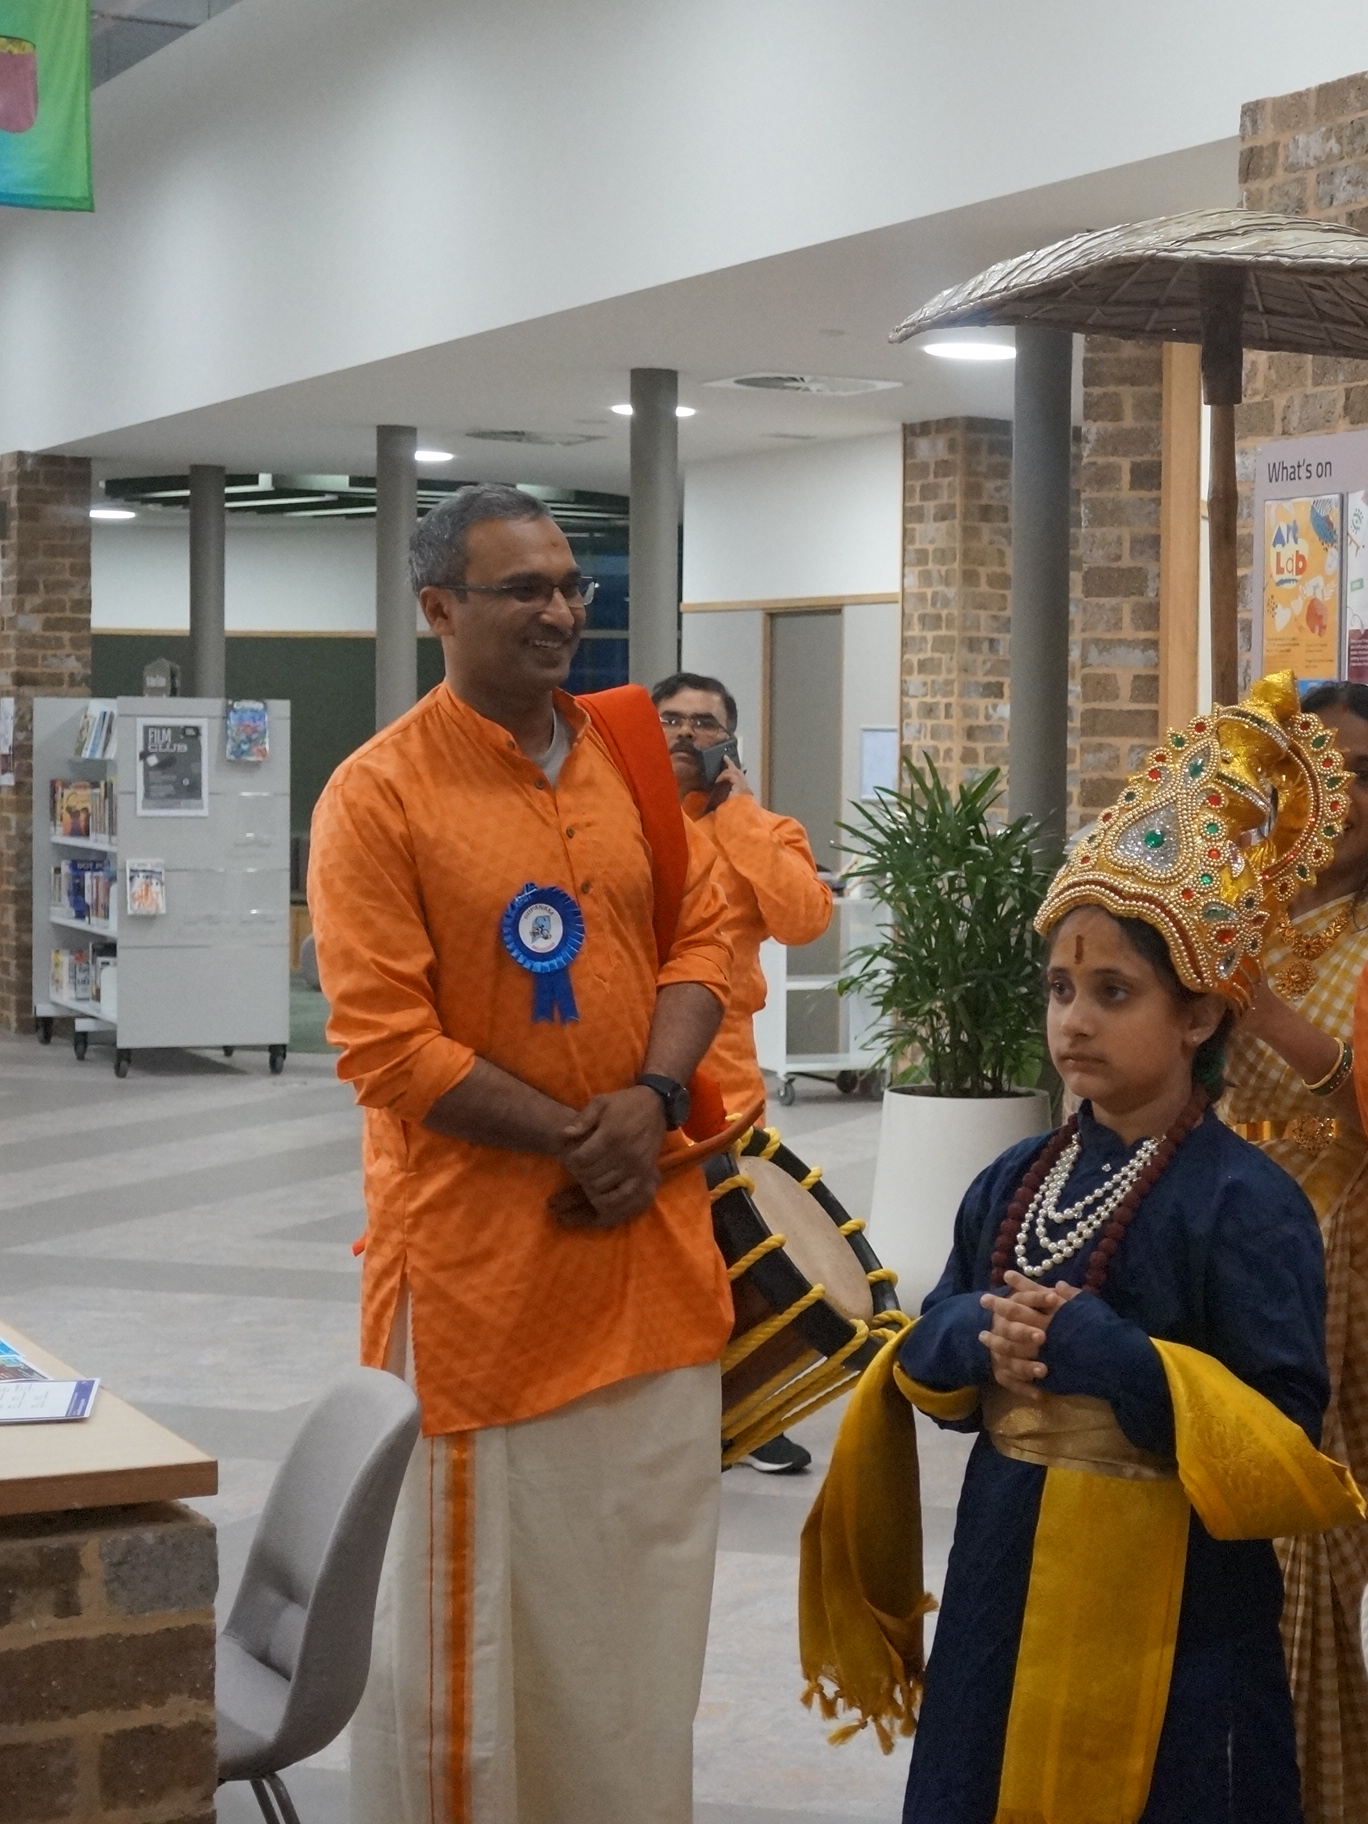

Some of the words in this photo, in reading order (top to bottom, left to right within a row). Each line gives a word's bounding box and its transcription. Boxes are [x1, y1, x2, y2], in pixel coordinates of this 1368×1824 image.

[1267, 459, 1312, 483] What's
[1316, 461, 1332, 478] on
[1276, 550, 1307, 576] Lab
[148, 727, 172, 743] FILM
